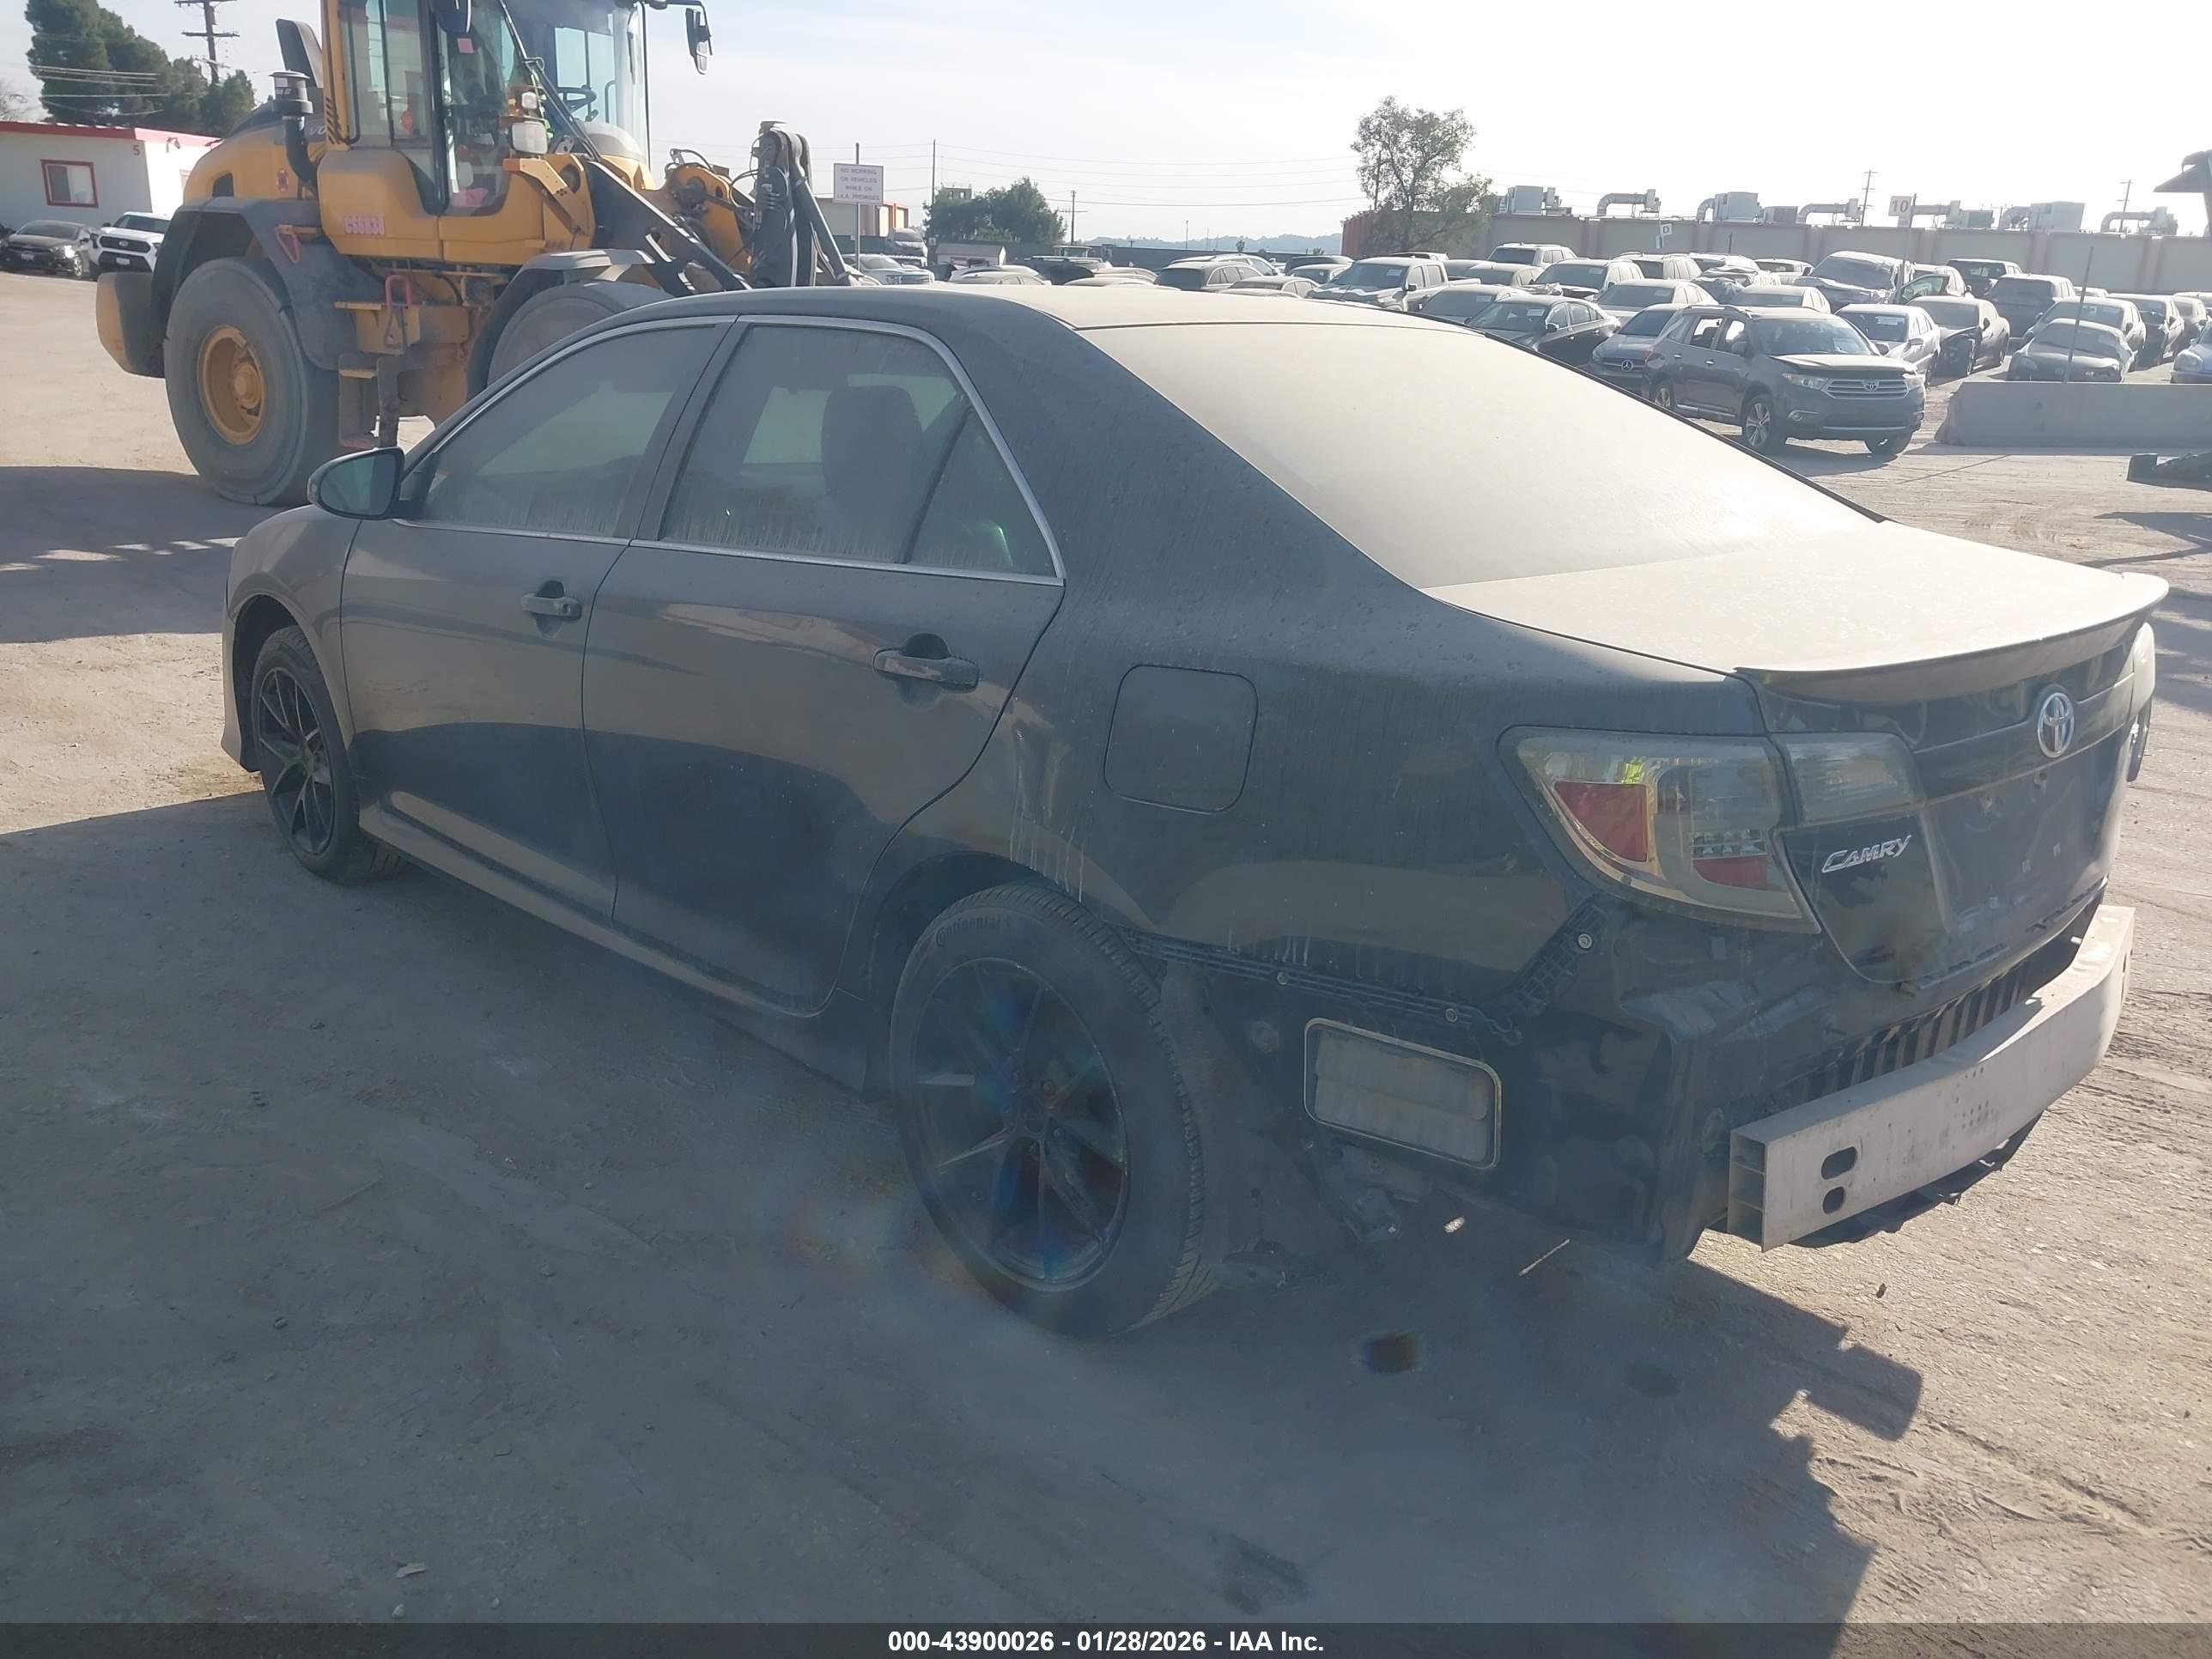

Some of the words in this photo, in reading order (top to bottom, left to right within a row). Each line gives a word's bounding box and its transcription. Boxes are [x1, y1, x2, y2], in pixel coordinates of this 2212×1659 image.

[132, 144, 141, 156] 5
[1891, 199, 1909, 213] 10
[1662, 226, 1670, 234] D
[1821, 834, 1912, 874] CAMRY
